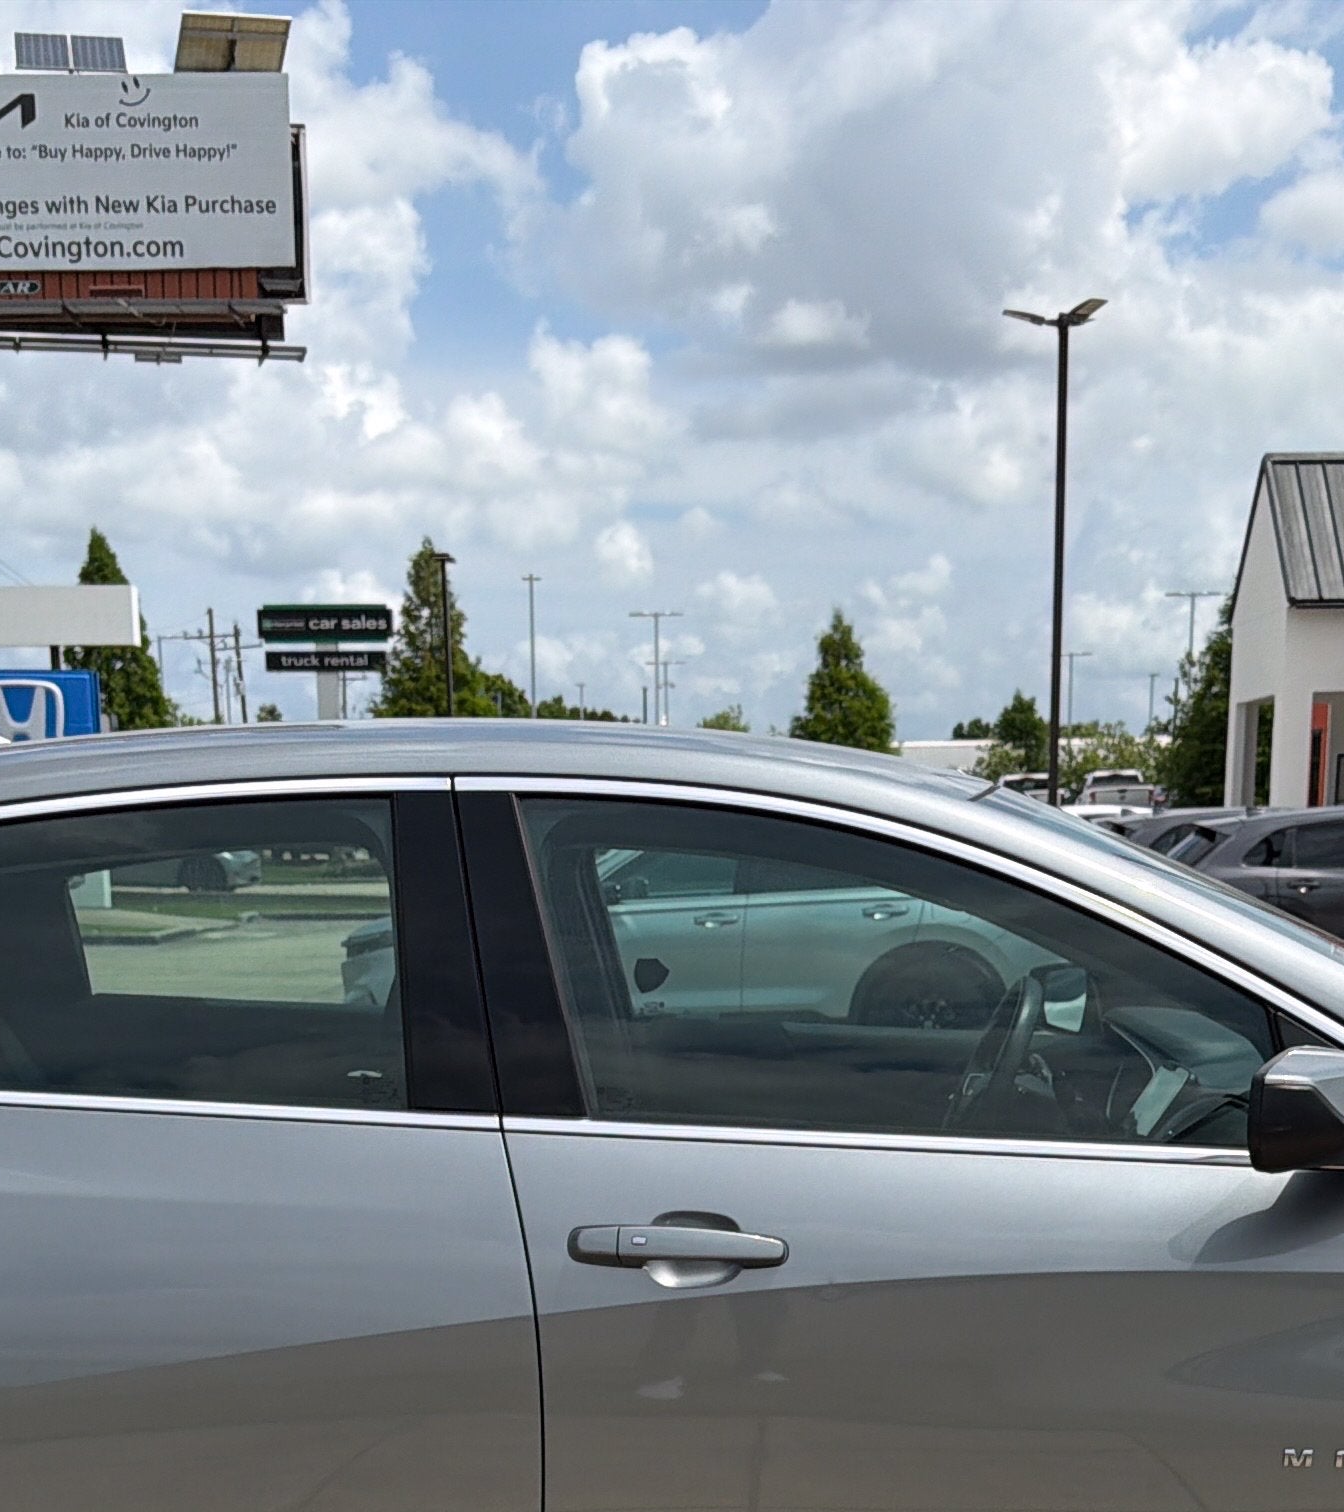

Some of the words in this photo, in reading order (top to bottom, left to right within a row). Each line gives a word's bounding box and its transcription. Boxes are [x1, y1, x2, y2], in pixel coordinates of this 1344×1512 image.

[64, 113, 90, 129] Kia
[94, 112, 111, 129] of
[115, 113, 199, 132] Covington
[7, 145, 27, 160] to:
[71, 143, 126, 163] Happy,
[130, 143, 171, 159] Drive
[45, 195, 89, 214] with
[95, 195, 140, 214] New
[145, 195, 178, 214] Kia
[184, 195, 277, 214] Purchase
[308, 618, 338, 630] car
[341, 614, 387, 630] sales
[281, 655, 320, 667] truck
[323, 654, 369, 667] rental
